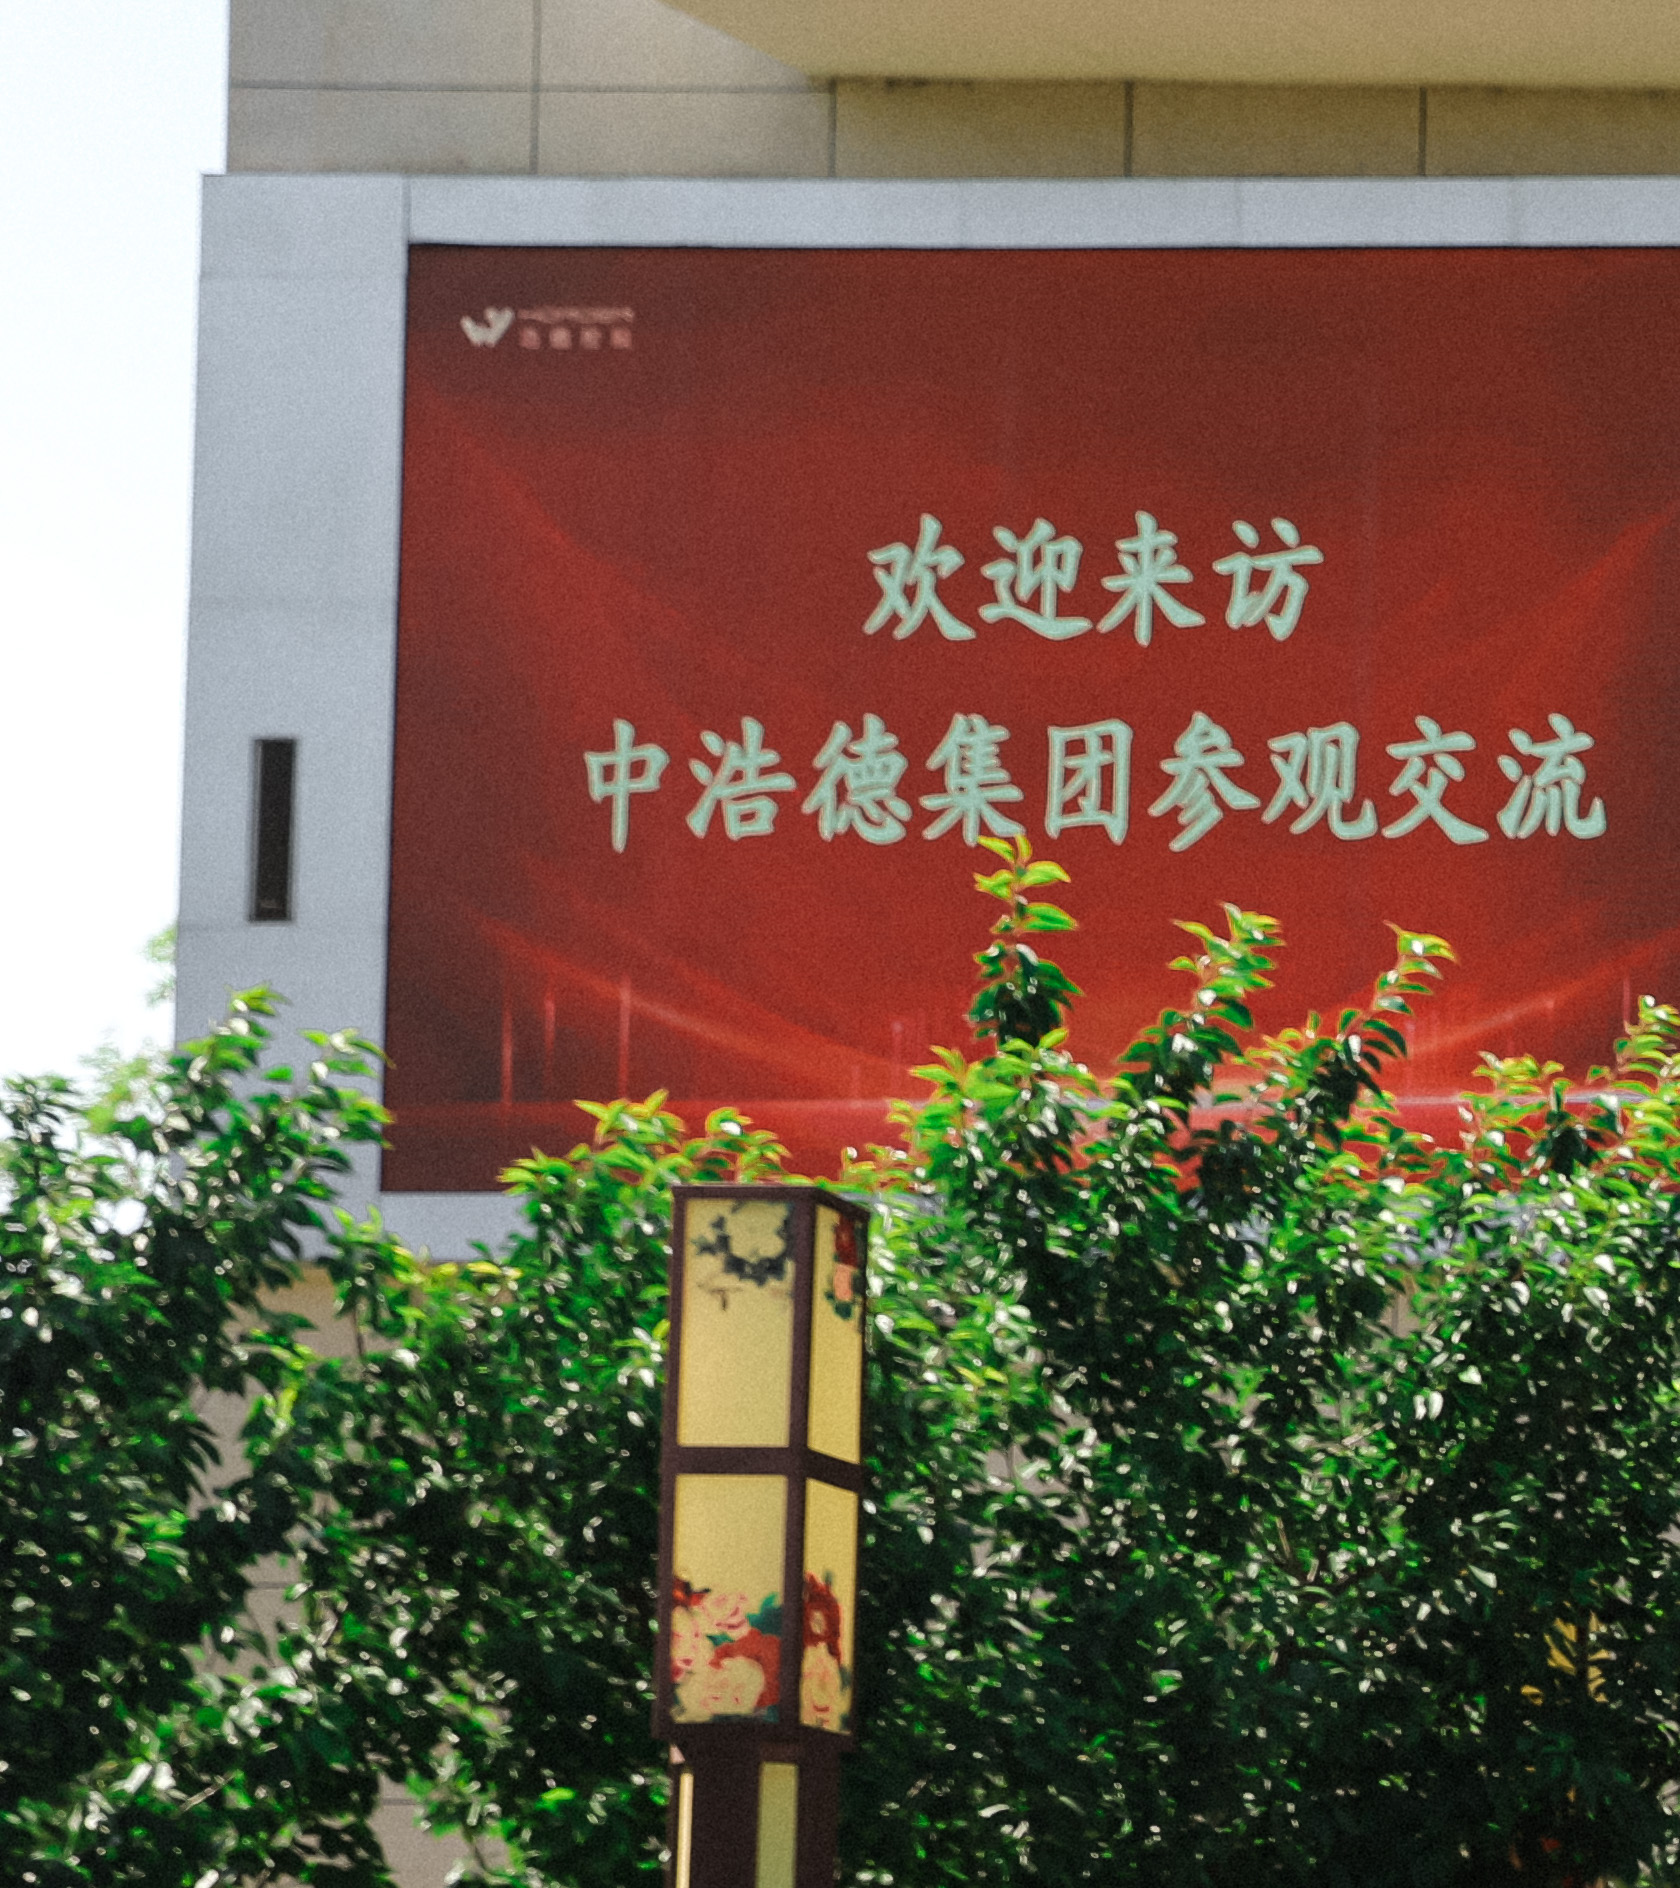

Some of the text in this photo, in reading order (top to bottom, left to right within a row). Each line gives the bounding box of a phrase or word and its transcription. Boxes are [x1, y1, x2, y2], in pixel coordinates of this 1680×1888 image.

[862, 510, 1324, 646] 欢迎来访
[586, 711, 1607, 854] 中浩德集团参观交流
